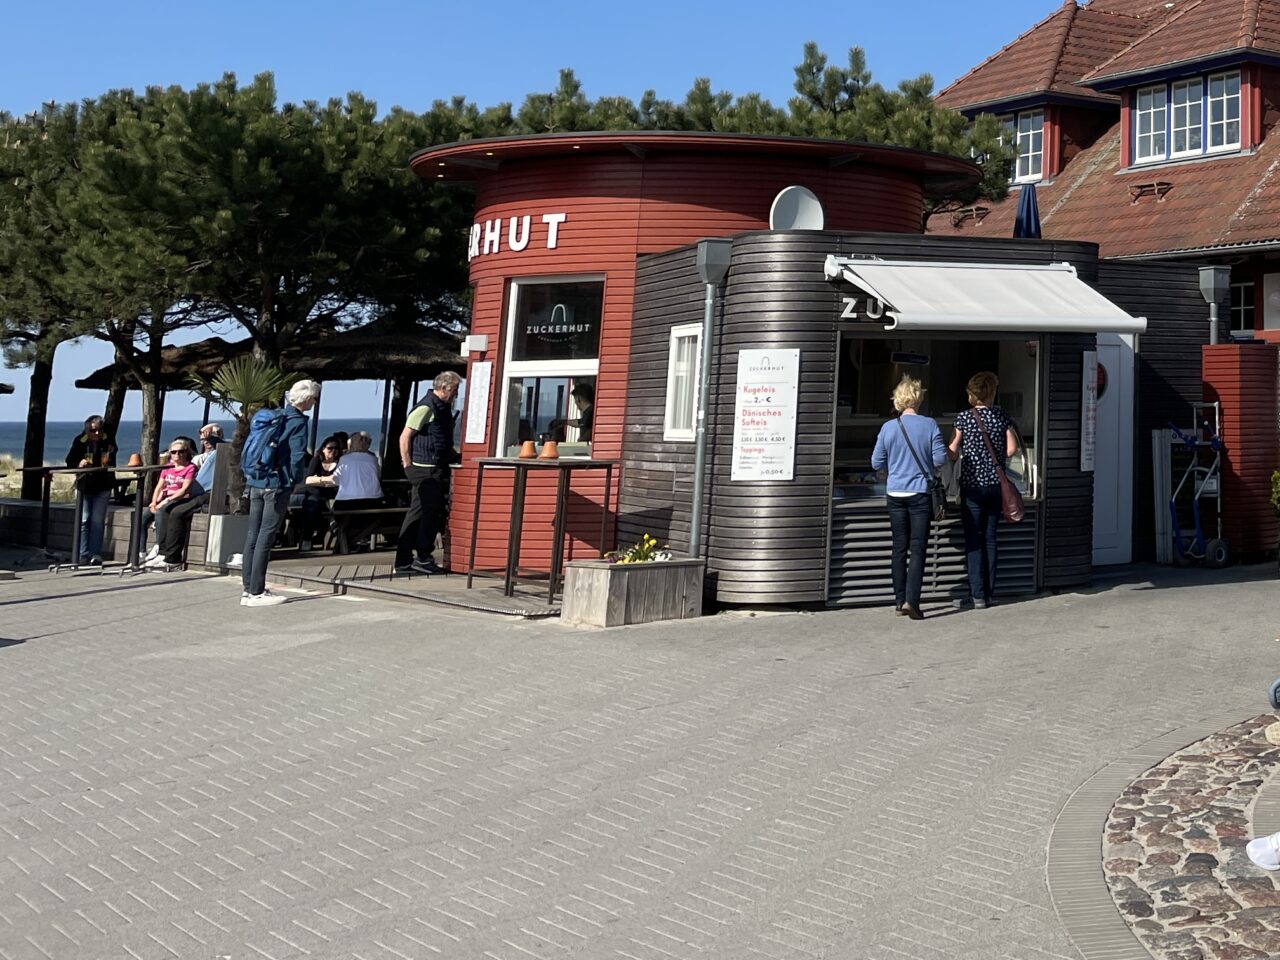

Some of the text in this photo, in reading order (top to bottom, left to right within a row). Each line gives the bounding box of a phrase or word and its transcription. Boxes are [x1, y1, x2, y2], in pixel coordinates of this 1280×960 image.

[526, 323, 591, 334] ZUCKERHUT
[743, 385, 776, 395] Kugeleis
[742, 408, 782, 418] Dänisches
[741, 417, 768, 427] Softeis
